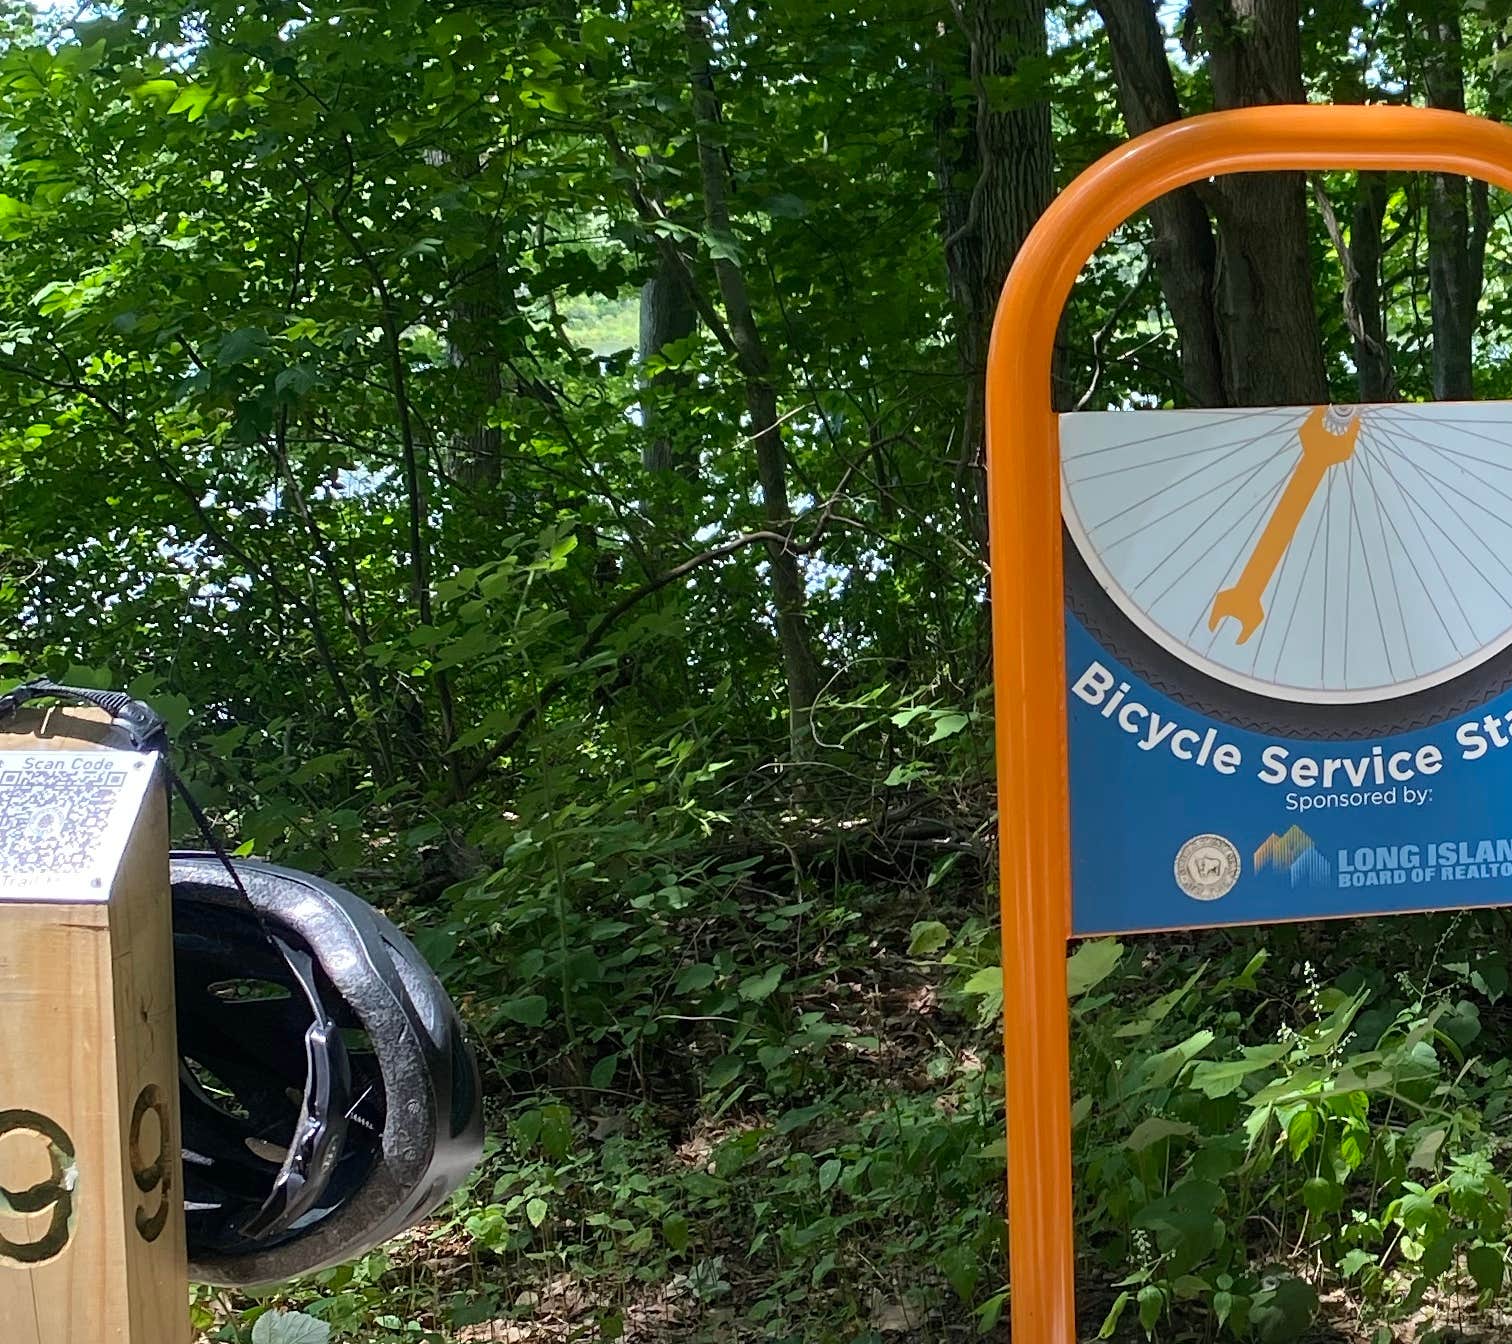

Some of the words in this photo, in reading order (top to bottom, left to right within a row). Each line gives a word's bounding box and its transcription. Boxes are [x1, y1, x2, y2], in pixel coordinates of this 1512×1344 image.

[1071, 660, 1242, 775] Bicycle
[1257, 744, 1443, 788] Service
[23, 757, 65, 770] Scan
[71, 758, 114, 770] Code
[1285, 787, 1396, 812] Sponsored
[1403, 786, 1433, 806] by:
[1338, 845, 1421, 872] LONG
[1338, 870, 1406, 888] BOARD
[1411, 868, 1436, 883] OF
[129, 1083, 171, 1244] 9
[0, 1109, 79, 1268] 9
